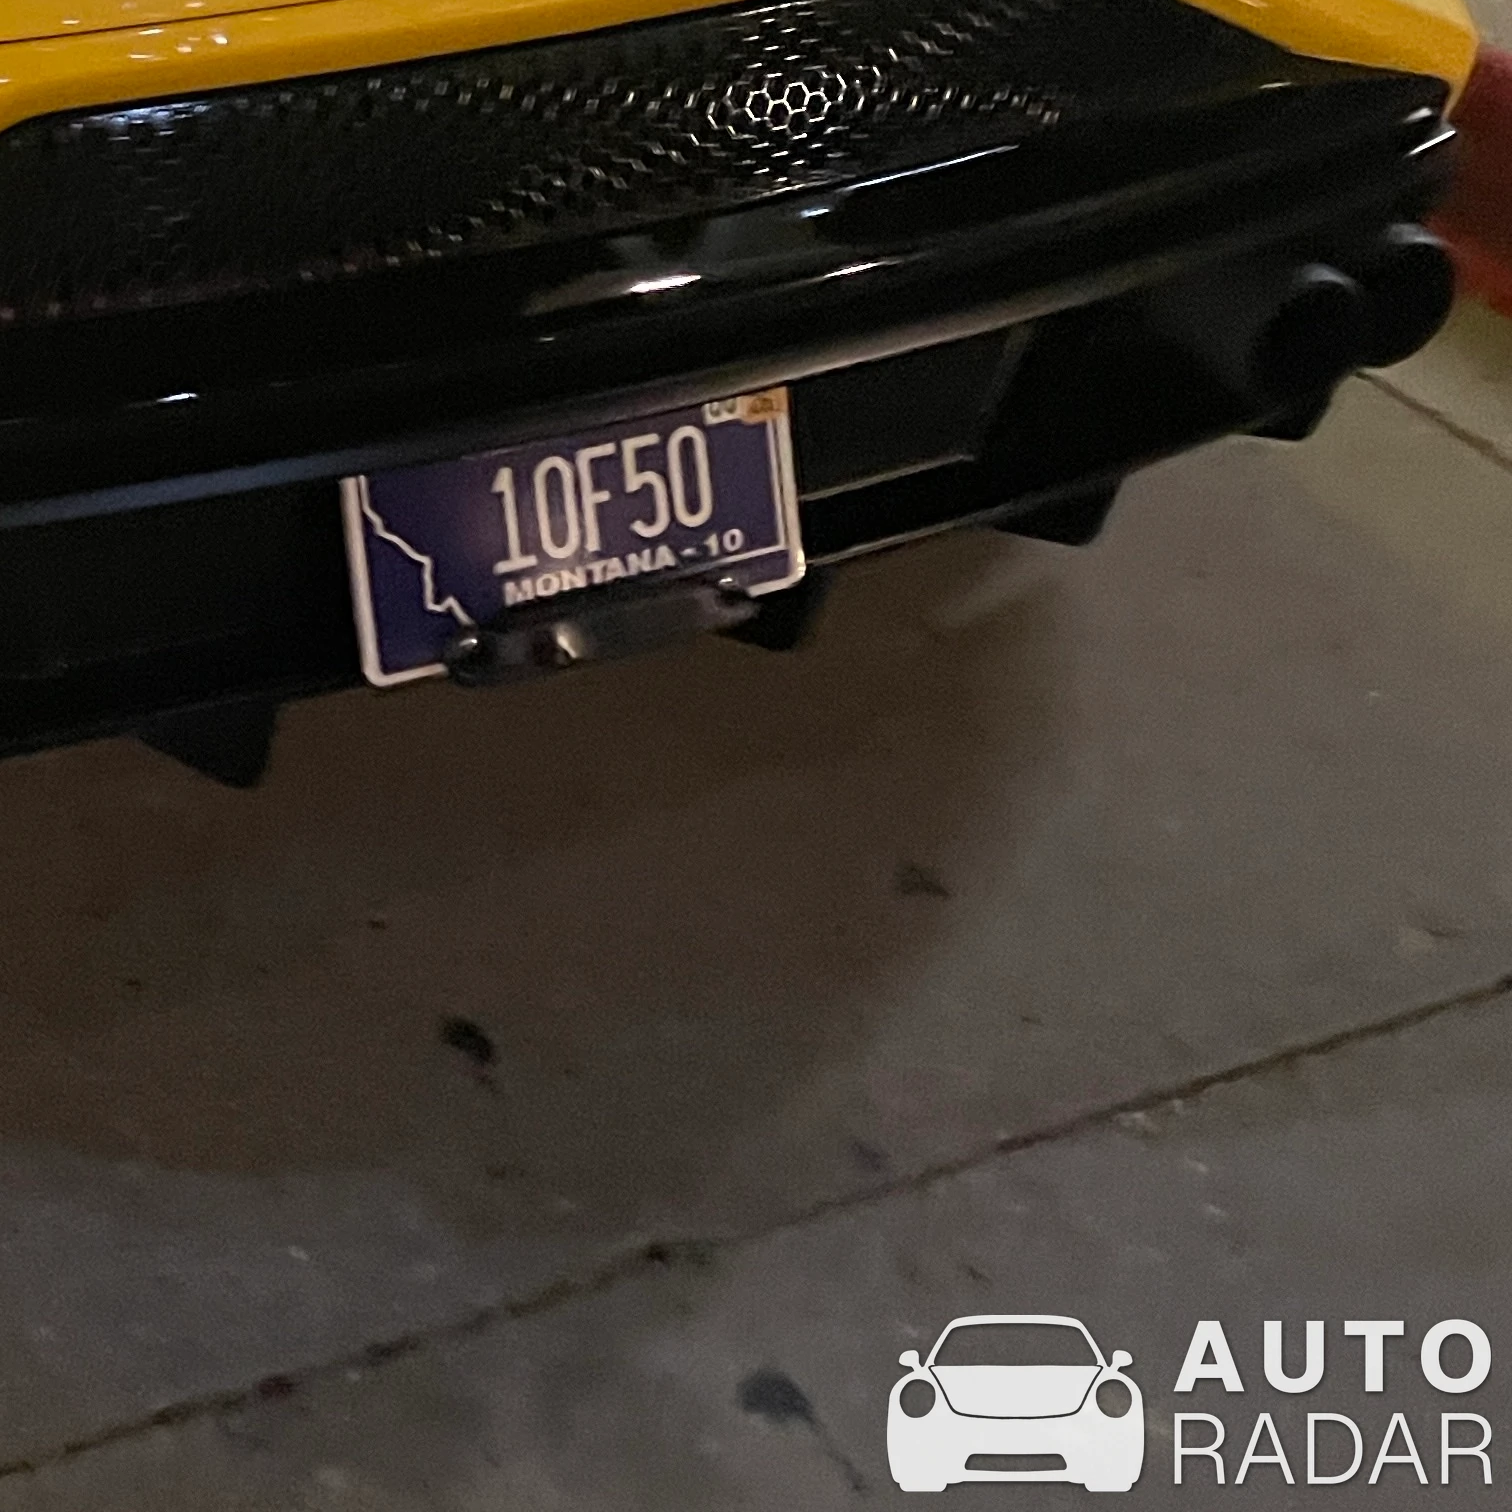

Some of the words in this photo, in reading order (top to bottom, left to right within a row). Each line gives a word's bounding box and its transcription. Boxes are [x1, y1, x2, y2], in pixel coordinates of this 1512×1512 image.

[491, 425, 713, 576] 10F50
[503, 543, 678, 607] MONTANA
[703, 528, 744, 557] 10
